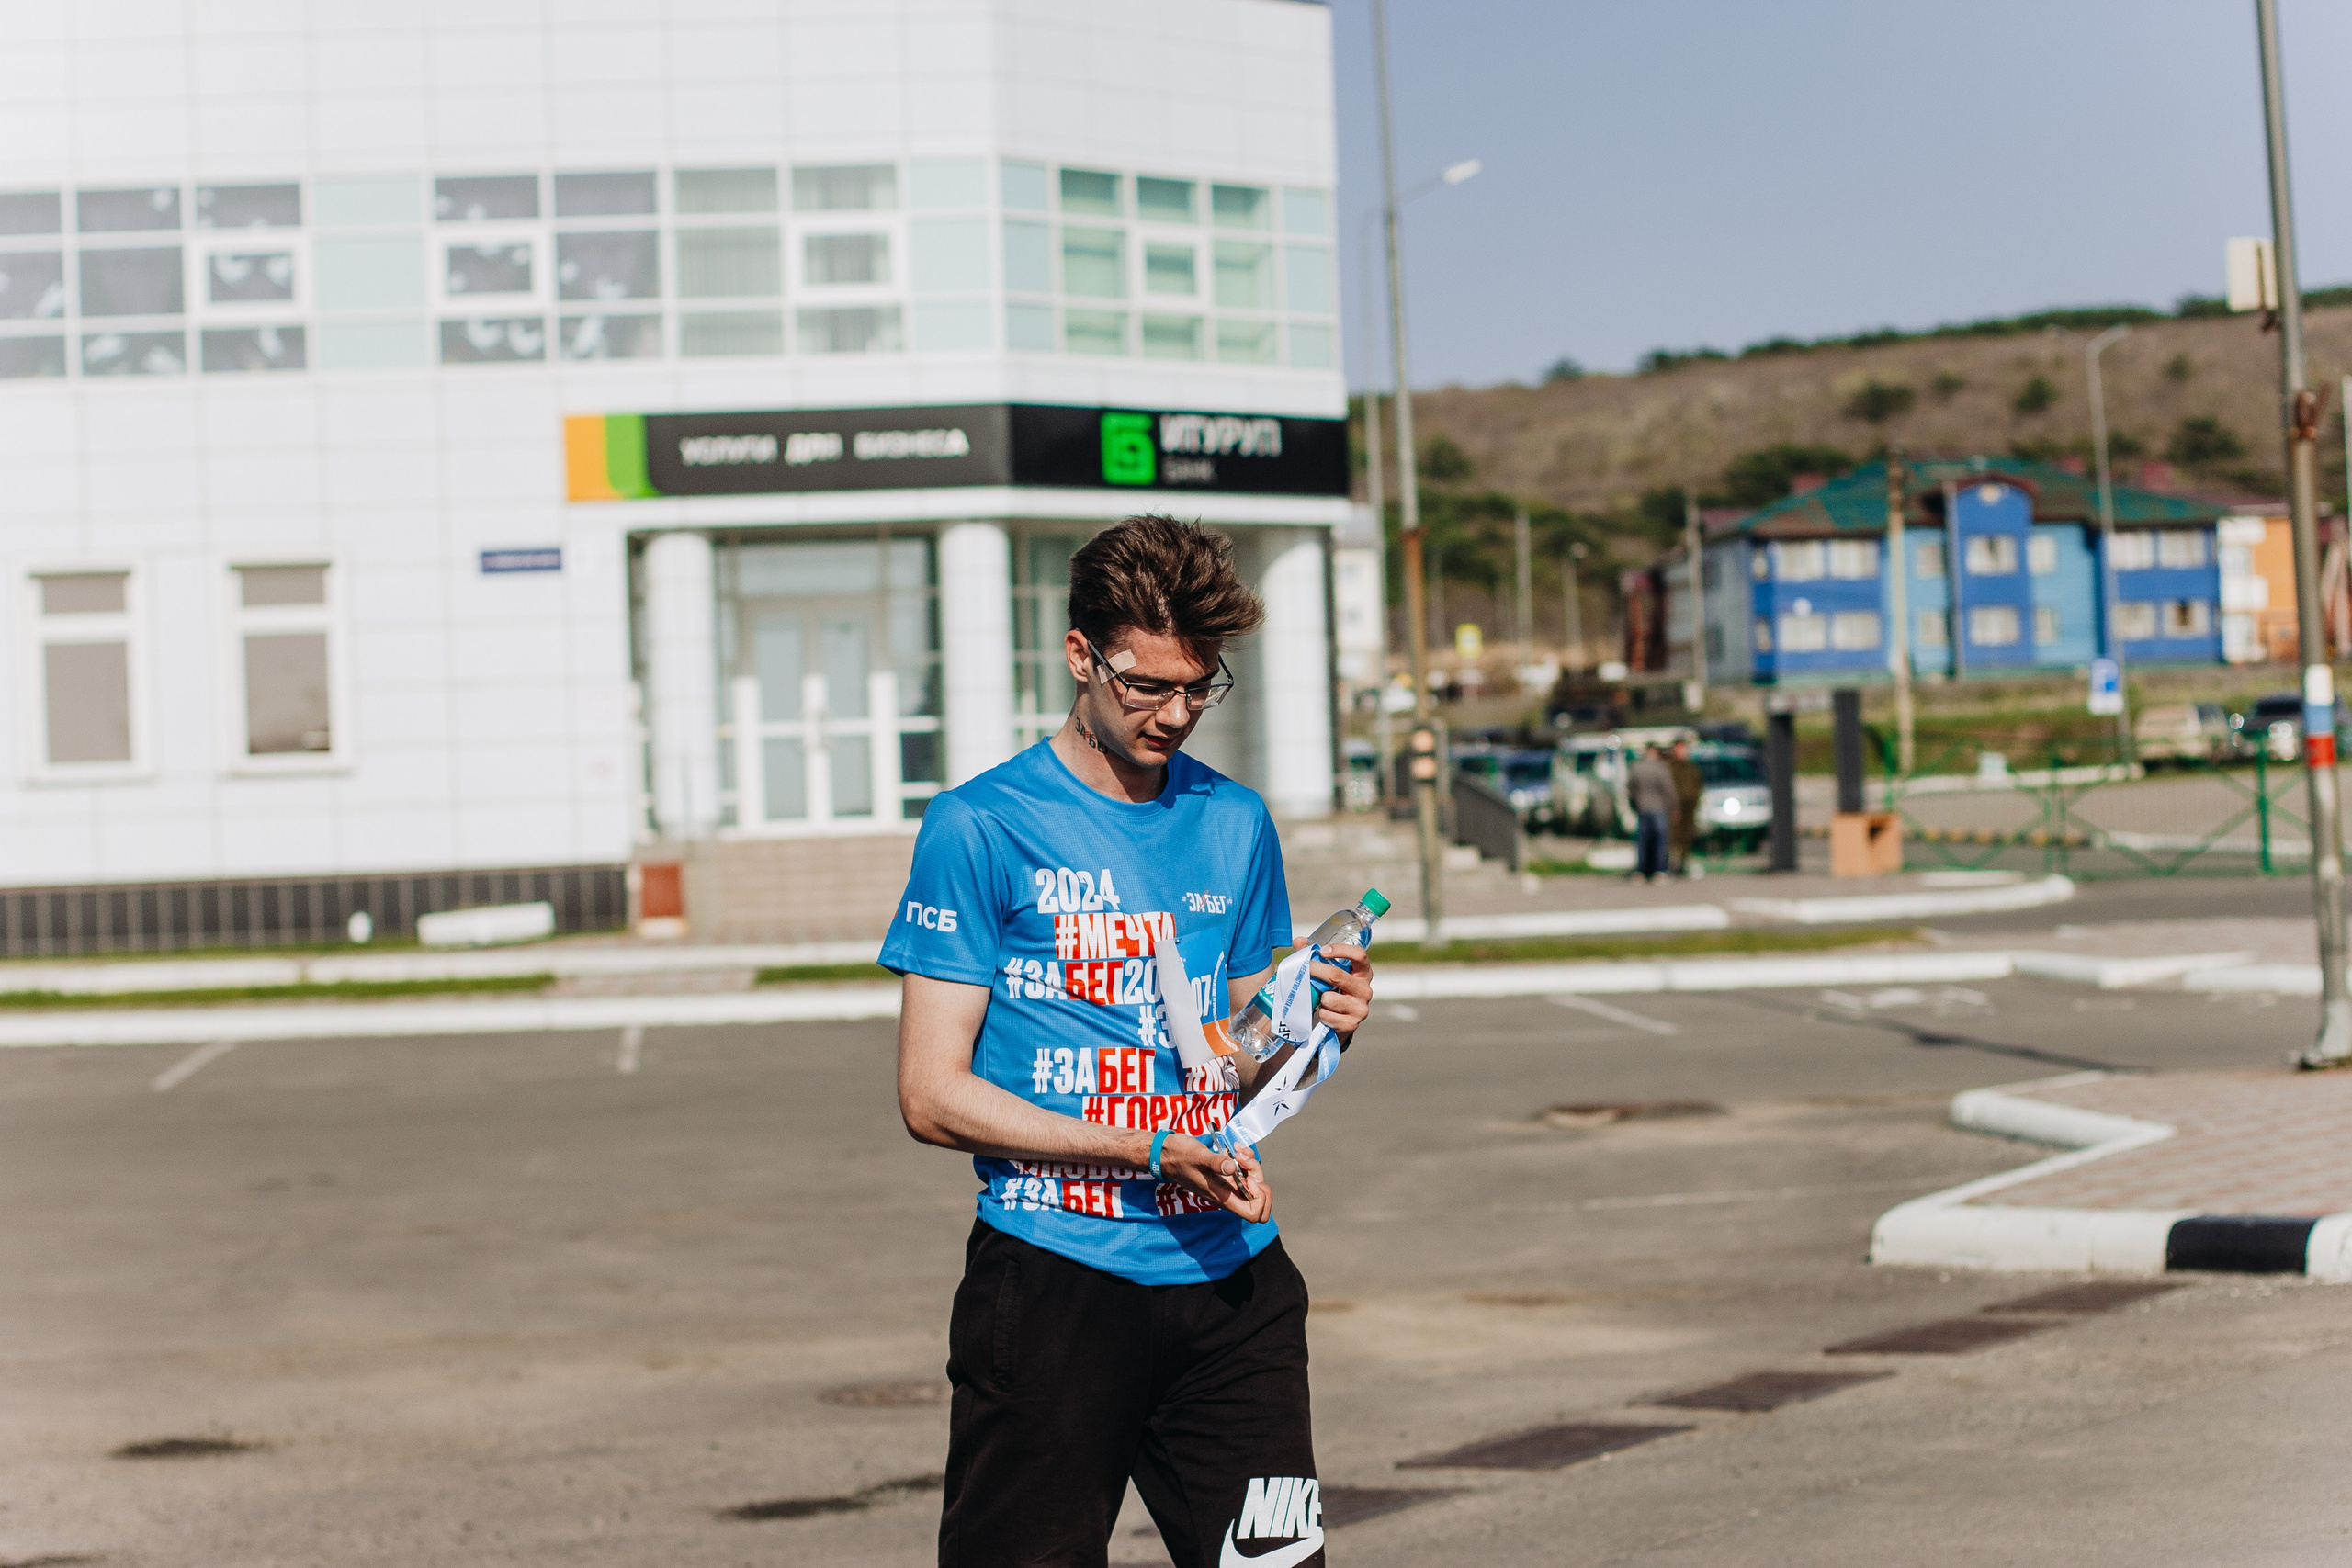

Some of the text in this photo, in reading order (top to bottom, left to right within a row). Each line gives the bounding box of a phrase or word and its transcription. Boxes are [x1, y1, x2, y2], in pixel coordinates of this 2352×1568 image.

[679, 428, 970, 466] УСЛУГИ ДЛЯ БИЗНЕСА
[1159, 413, 1282, 457] ИТУРУП
[1035, 867, 1120, 914] 2024
[906, 901, 957, 932] ПСБ
[1032, 1048, 1156, 1094] #ЗАБЕГ
[1000, 1178, 1124, 1218] #ЗАБЕГ
[1237, 1477, 1323, 1539] NIKE
